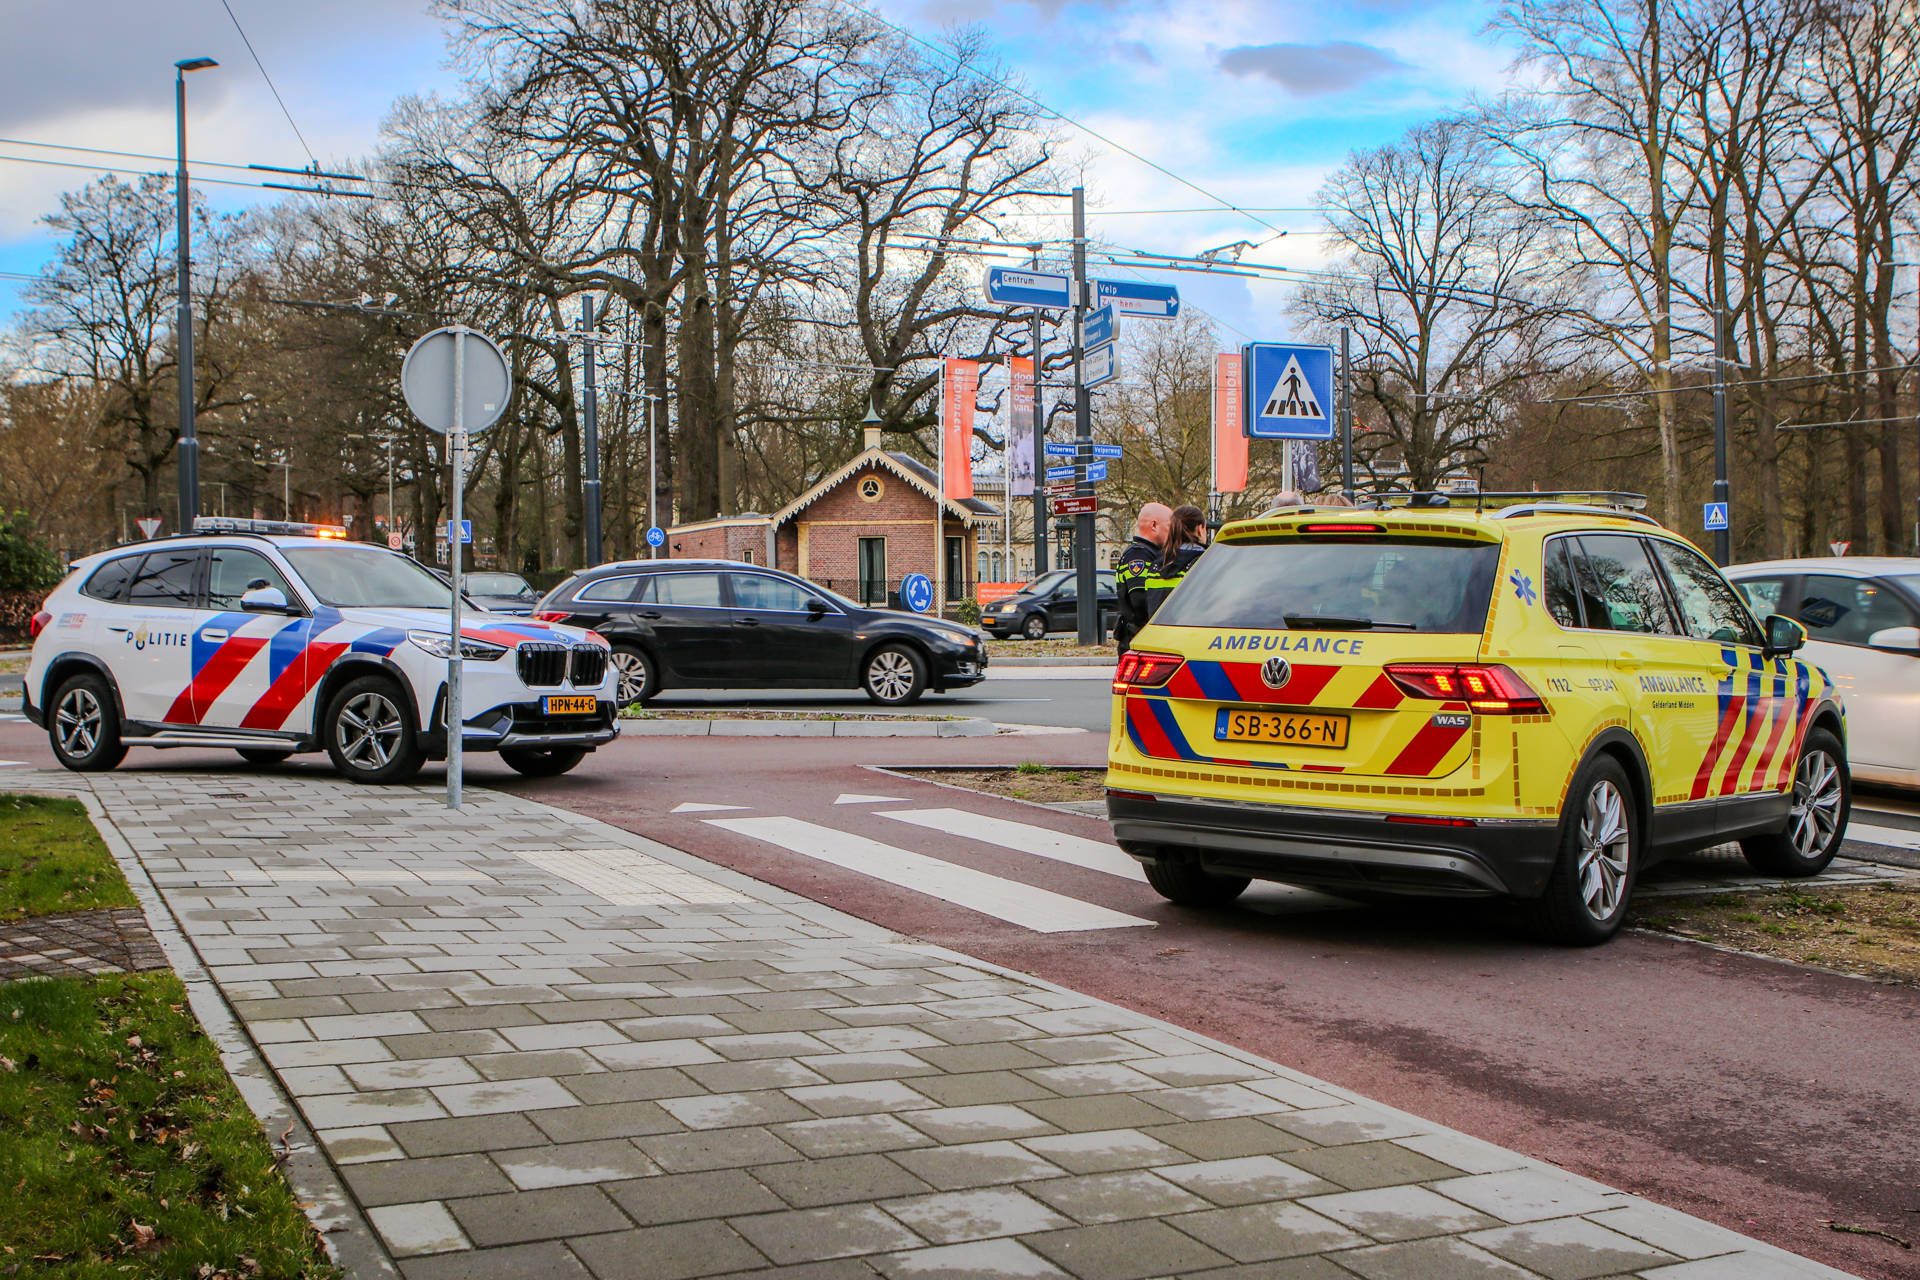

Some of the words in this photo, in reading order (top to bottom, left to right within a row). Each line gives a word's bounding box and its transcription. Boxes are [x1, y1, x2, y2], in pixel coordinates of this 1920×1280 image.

[1003, 274, 1035, 285] Centrum
[1099, 283, 1118, 295] Velp
[953, 367, 964, 433] BRONBEEK
[1226, 362, 1238, 429] BRONBEEK
[1048, 445, 1075, 455] Velperweg
[1094, 446, 1121, 456] Velperweg
[126, 630, 187, 651] POLITIE
[1207, 635, 1365, 656] AMBULANCE
[1551, 678, 1573, 693] 112
[1639, 675, 1707, 694] AMBULANCE
[550, 698, 595, 712] HPN-44-G
[1652, 700, 1678, 709] Gelderland
[1678, 700, 1695, 709] Midden
[1217, 727, 1227, 735] NL
[1232, 714, 1338, 742] SB-366-N
